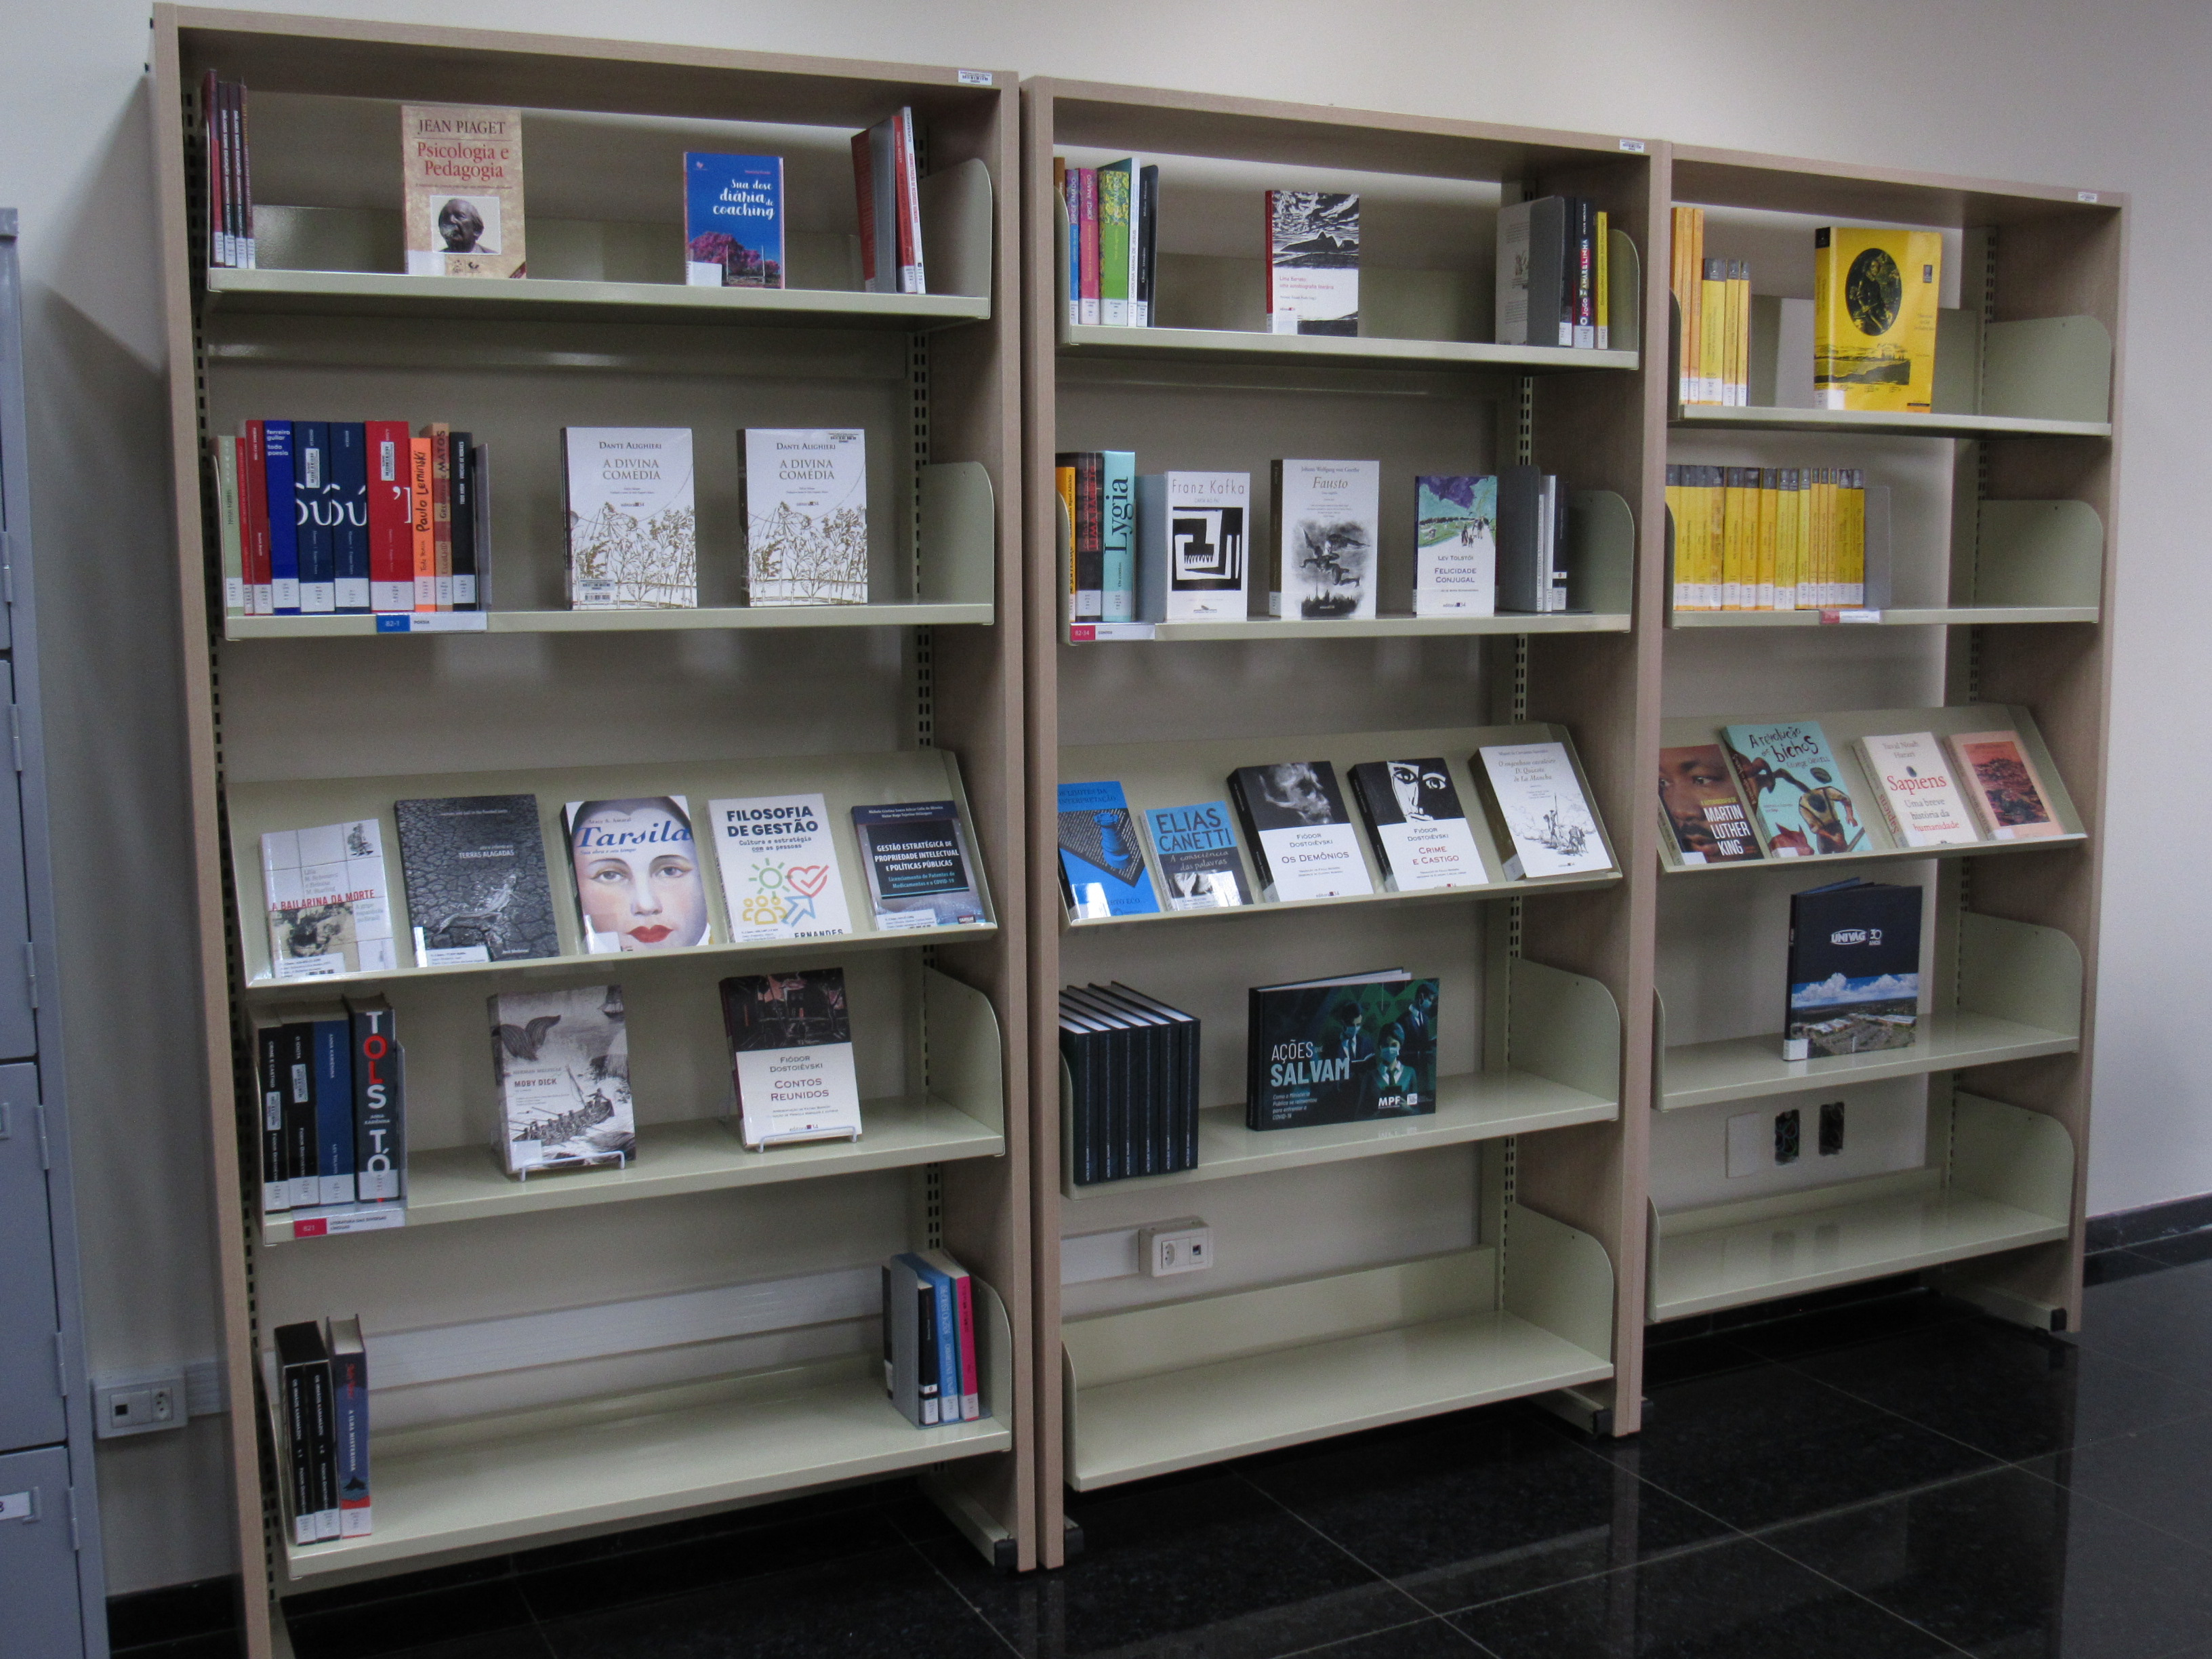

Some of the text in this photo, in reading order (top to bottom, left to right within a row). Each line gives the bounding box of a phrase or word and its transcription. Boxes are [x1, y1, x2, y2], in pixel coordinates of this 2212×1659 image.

[417, 119, 506, 135] JEAN PIAGET
[417, 142, 510, 163] Psicologia e
[424, 160, 504, 182] Pedagogia
[731, 179, 773, 190] Sua dose
[720, 187, 766, 203] diária
[712, 203, 775, 220] coaching
[1580, 239, 1589, 289] AMARELINHA
[437, 430, 450, 474] MATOS
[599, 441, 662, 450] DANTE ALIGHIERI
[603, 459, 659, 468] A DIVINA
[780, 459, 834, 469] A DIVINA
[602, 468, 662, 480] COMÉDIA
[779, 468, 835, 480] COMÉDIA
[1172, 478, 1245, 495] Franz Kafka
[1312, 476, 1348, 489] Fausto
[415, 451, 431, 533] Paulo Leminski
[1088, 466, 1097, 549] LIMA BARRETO
[1104, 476, 1134, 554] Lygia
[1748, 726, 1802, 749] A revolução
[1770, 735, 1820, 763] bichos
[1902, 740, 1919, 749] Noah
[1894, 750, 1916, 759] Harari
[1887, 775, 1948, 796] Sapiens
[1904, 798, 1946, 808] Uma breve
[726, 805, 814, 823] FILOSOFIA
[1703, 804, 1744, 823] MARTIN
[1879, 794, 1899, 835] Sapiens
[1910, 810, 1950, 821] história da
[1155, 807, 1221, 834] ELIAS
[1912, 821, 1960, 832] humanidade
[576, 821, 694, 848] Tarsila
[726, 818, 819, 838] DE GESTÃO
[1414, 826, 1438, 834] FIÓDOR
[1710, 821, 1751, 840] LUTHER
[739, 838, 766, 846] Cultura
[1159, 827, 1233, 853] CANETTI
[1296, 832, 1322, 840] FIÓDOR
[1407, 833, 1449, 842] DOSTOIÉVSKI
[775, 844, 802, 852] pessoas
[877, 842, 901, 852] GESTÃO
[902, 840, 944, 851] ESTRATÉGICA
[1289, 838, 1334, 848] DOSTOIÉVSKI
[1717, 839, 1744, 856] KING
[458, 849, 514, 859] TERRAS ALAGADAS
[874, 849, 960, 863] PROPRIEDADE INTELECTUAL
[1170, 851, 1229, 862] A consciência
[1418, 845, 1448, 855] CRIME
[1281, 851, 1350, 865] OS DEMÔNIOS
[1420, 854, 1460, 865] CASTIGO
[890, 861, 922, 872] POLÍTICAS
[922, 859, 953, 868] PÚBLICAS
[1180, 859, 1228, 871] das palavras
[272, 889, 375, 912] A BAILARINA DA MORTE
[1831, 928, 1883, 943] UNIVAG 30
[1271, 1039, 1313, 1064] AÇÕES
[779, 1055, 811, 1064] FIÓDOR
[770, 1063, 823, 1073] DOSTOIÉVSKI
[1270, 1058, 1350, 1088] SALVAM
[514, 1078, 557, 1088] MOBY DICK
[774, 1078, 823, 1090] CONTOS
[771, 1089, 830, 1102] REUNIDOS
[1378, 1095, 1401, 1107] MPF
